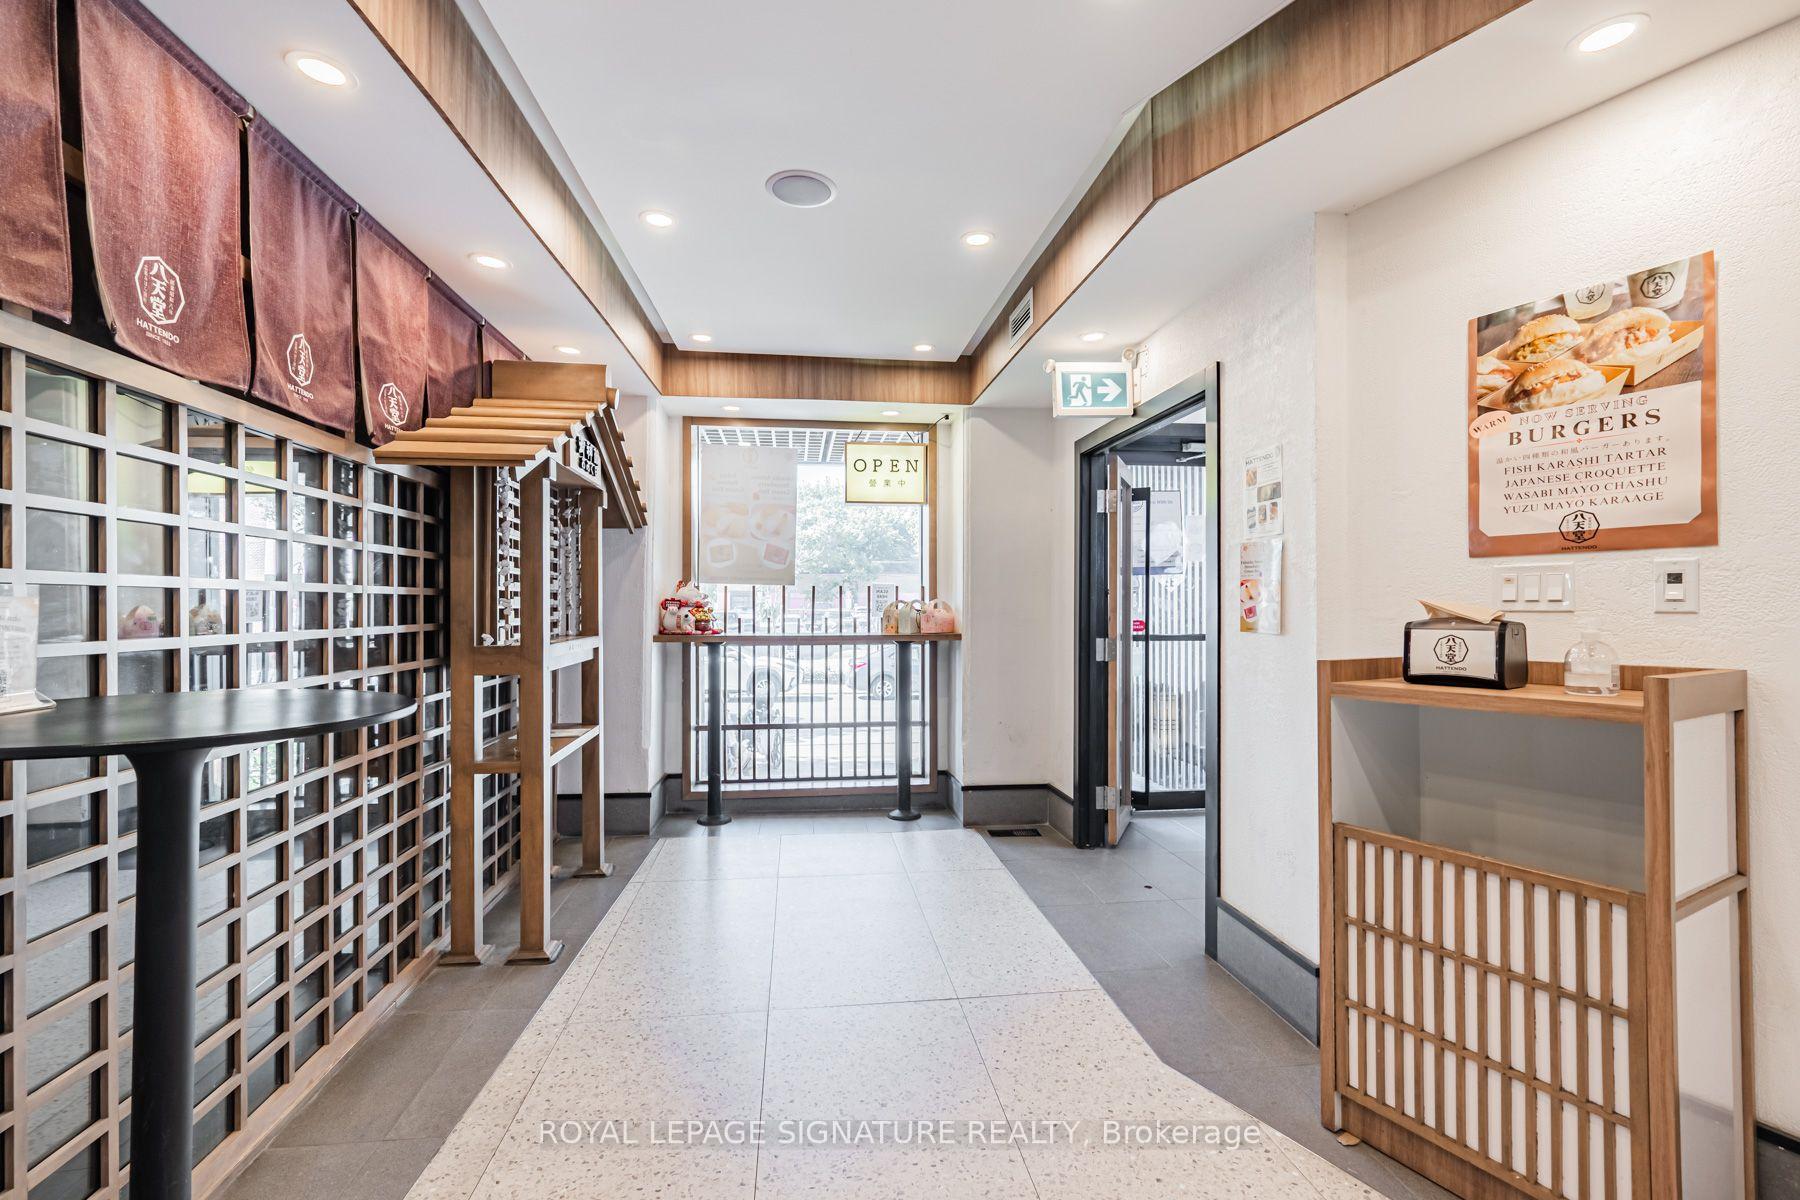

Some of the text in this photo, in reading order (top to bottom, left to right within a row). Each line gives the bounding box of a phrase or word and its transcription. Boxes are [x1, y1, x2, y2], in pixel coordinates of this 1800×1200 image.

[136, 317, 180, 344] HATTENDO
[287, 382, 314, 400] HATTENDO
[1519, 395, 1649, 426] NOW SERVING
[1472, 415, 1507, 434] WARM
[1509, 408, 1661, 446] BURGERS
[853, 458, 919, 473] OPEN
[1504, 446, 1668, 475] FISH KARASHI TARTAR
[1503, 475, 1668, 501] WASABI MAYO CHASHU
[1505, 461, 1667, 489] JAPANESE CROQUETTE
[1503, 491, 1665, 515] YUZU MAYO KARAAGE
